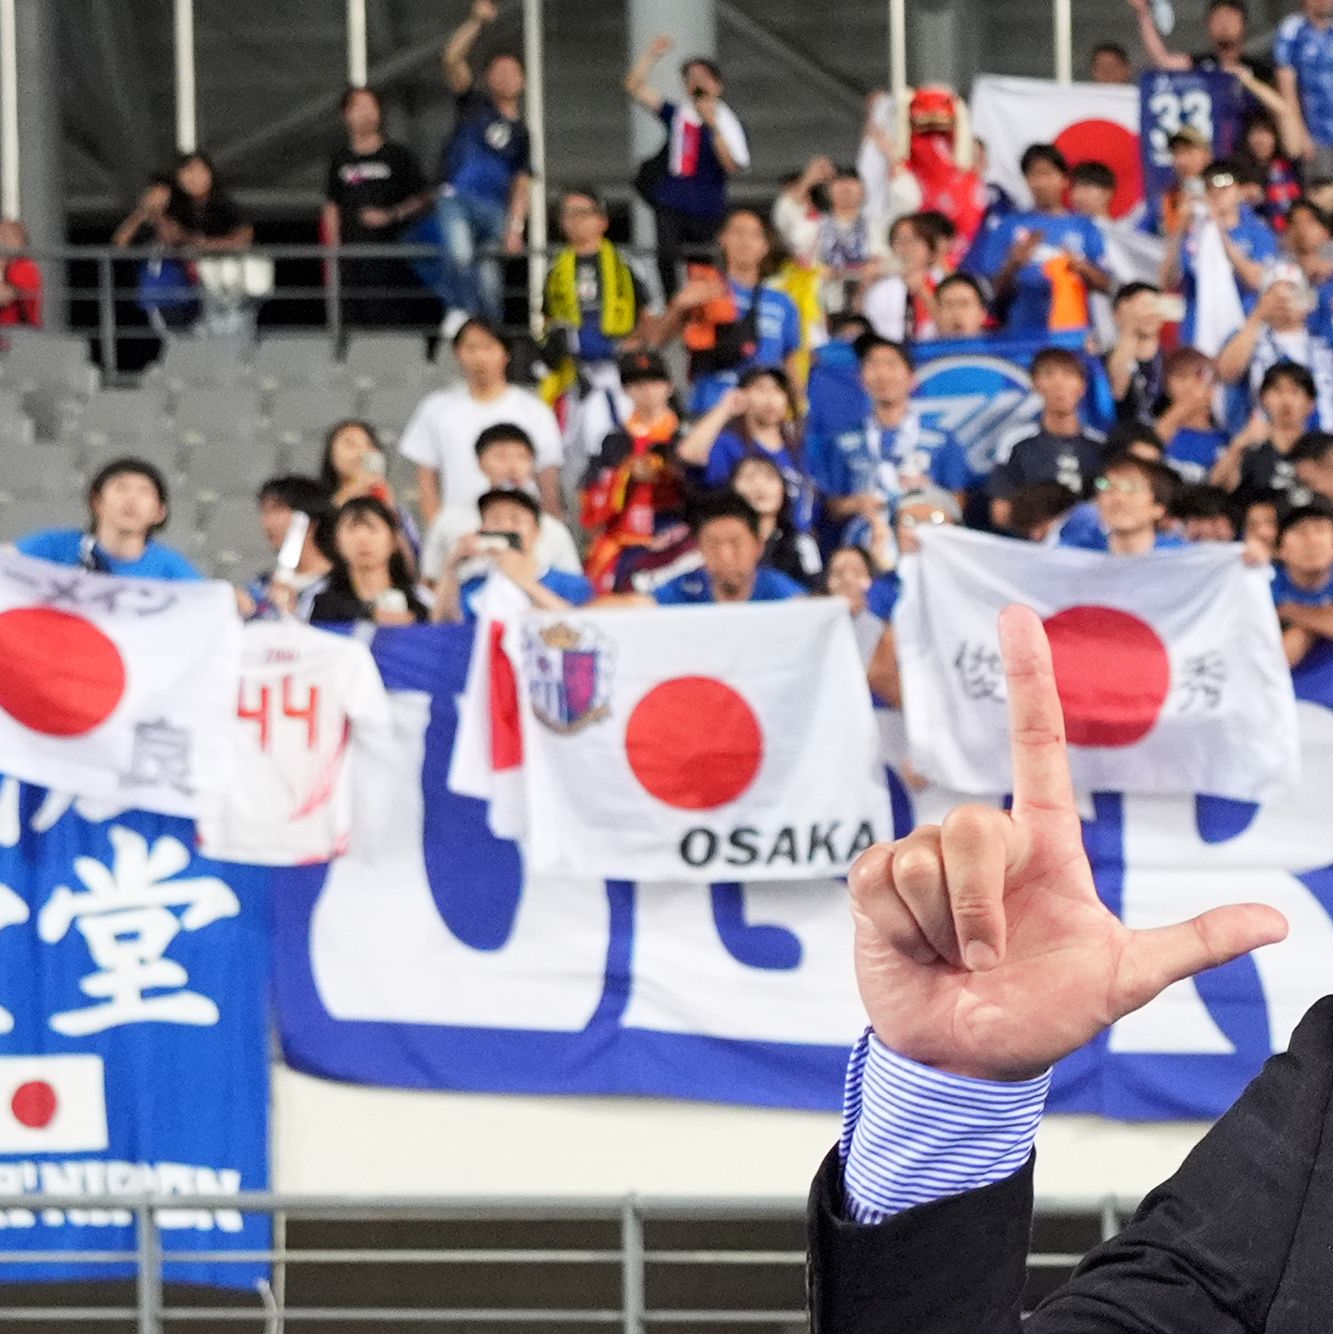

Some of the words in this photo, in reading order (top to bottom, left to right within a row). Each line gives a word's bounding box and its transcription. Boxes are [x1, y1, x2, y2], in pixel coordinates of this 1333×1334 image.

[237, 674, 319, 751] 44
[679, 822, 877, 868] OSAKA
[0, 825, 241, 1038] 堂
